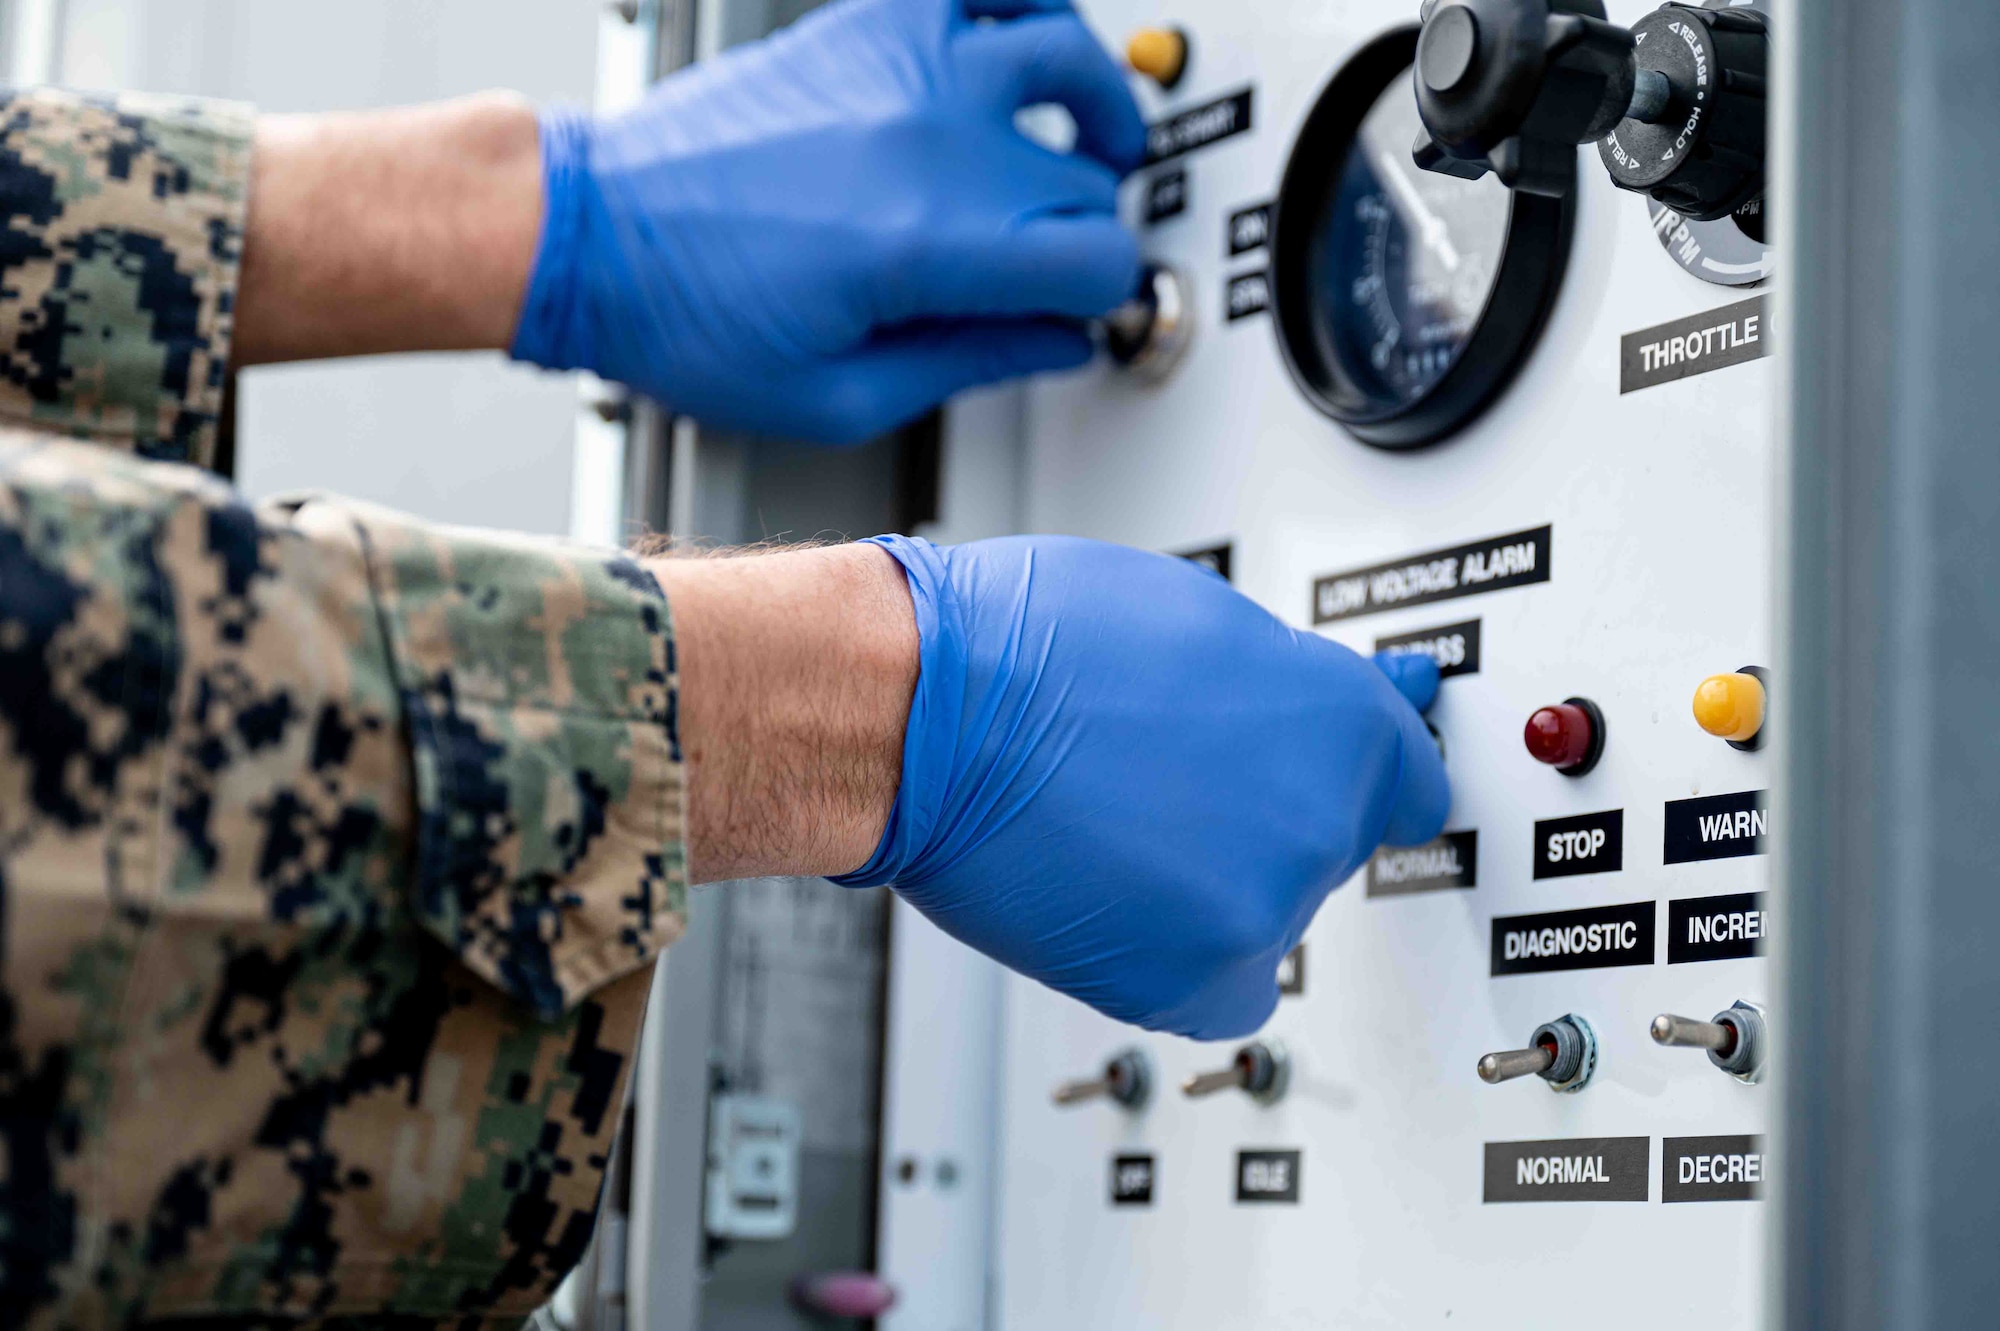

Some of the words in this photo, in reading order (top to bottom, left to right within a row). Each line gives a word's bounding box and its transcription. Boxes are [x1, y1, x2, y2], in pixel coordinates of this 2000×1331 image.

[1680, 24, 1707, 86] RELEASE
[1606, 129, 1628, 166] RELE
[1675, 106, 1702, 150] HOLD
[1639, 315, 1759, 372] THROTTLE
[1318, 575, 1370, 617] LOW
[1370, 557, 1459, 605] VOLTAGE
[1461, 541, 1536, 585] ALARM
[1548, 828, 1605, 862] STOP
[1504, 921, 1637, 960] DIAGNOSTIC
[1517, 1156, 1610, 1185] NORMAL
[1679, 1154, 1766, 1184] DECRE
